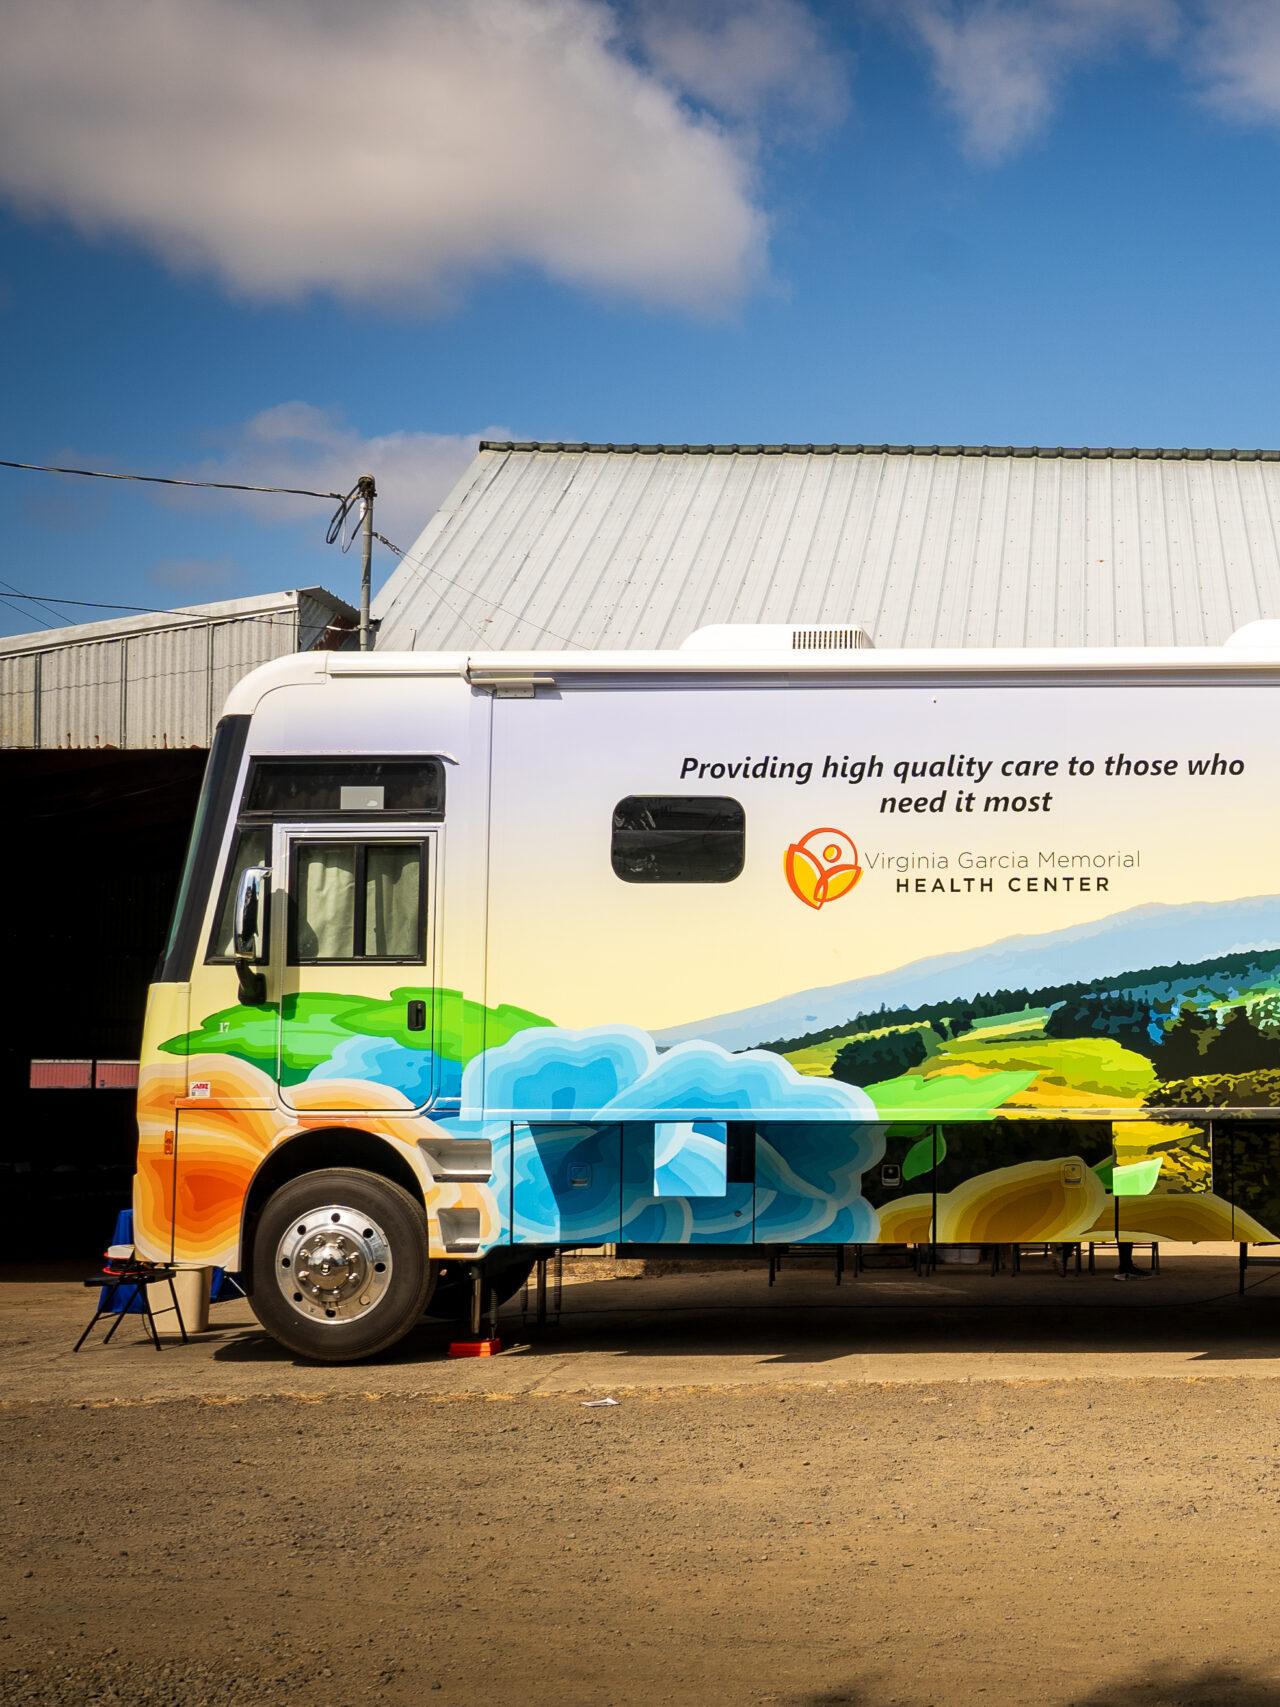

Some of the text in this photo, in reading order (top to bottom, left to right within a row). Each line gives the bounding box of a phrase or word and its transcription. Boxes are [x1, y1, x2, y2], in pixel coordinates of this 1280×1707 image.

[679, 752, 1245, 785] Providing high quality care to those who
[879, 790, 1053, 814] need it most
[865, 849, 1140, 872] Virginia Garcia Memorial
[896, 876, 1110, 893] HEALTH CENTER
[219, 1022, 230, 1033] 17
